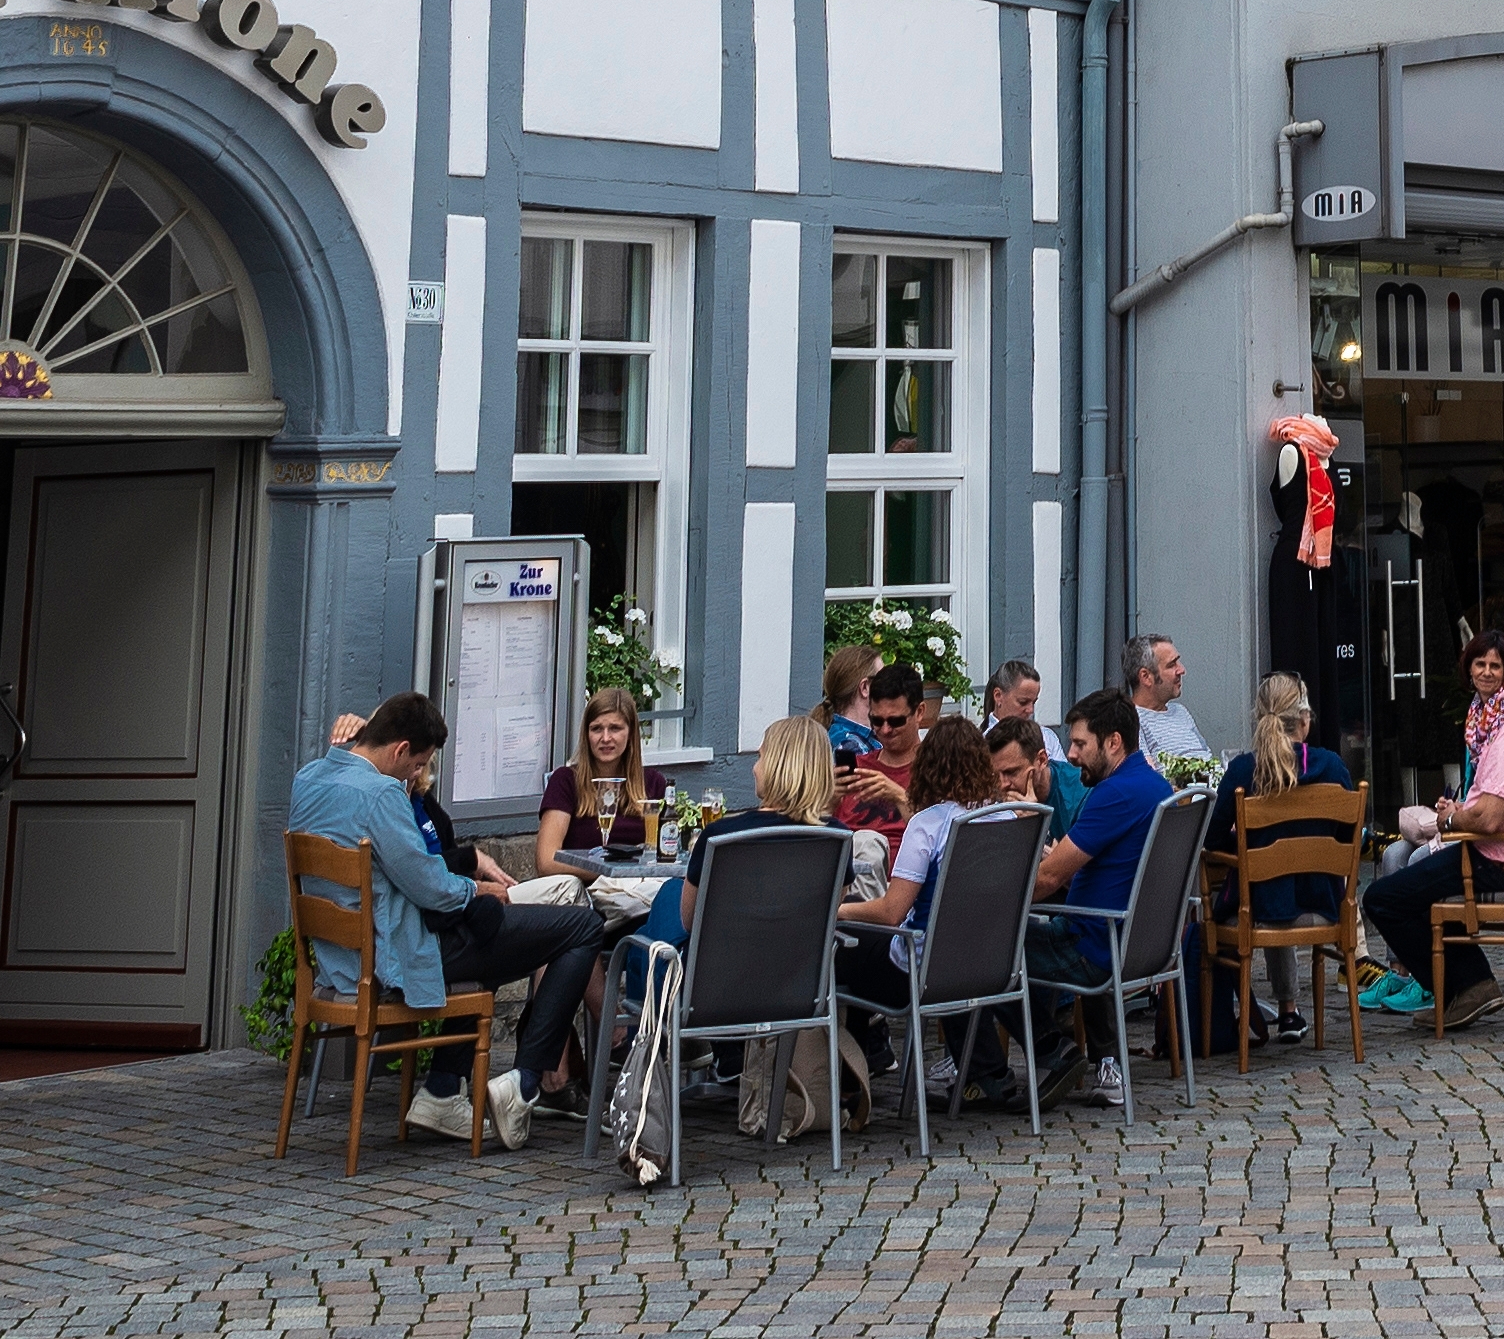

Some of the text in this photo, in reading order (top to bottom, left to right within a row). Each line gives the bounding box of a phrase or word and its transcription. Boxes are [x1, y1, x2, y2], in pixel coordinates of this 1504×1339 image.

[50, 24, 104, 39] ANNO
[1314, 190, 1363, 217] MIA
[519, 564, 544, 580] Zur
[509, 581, 552, 598] Krone
